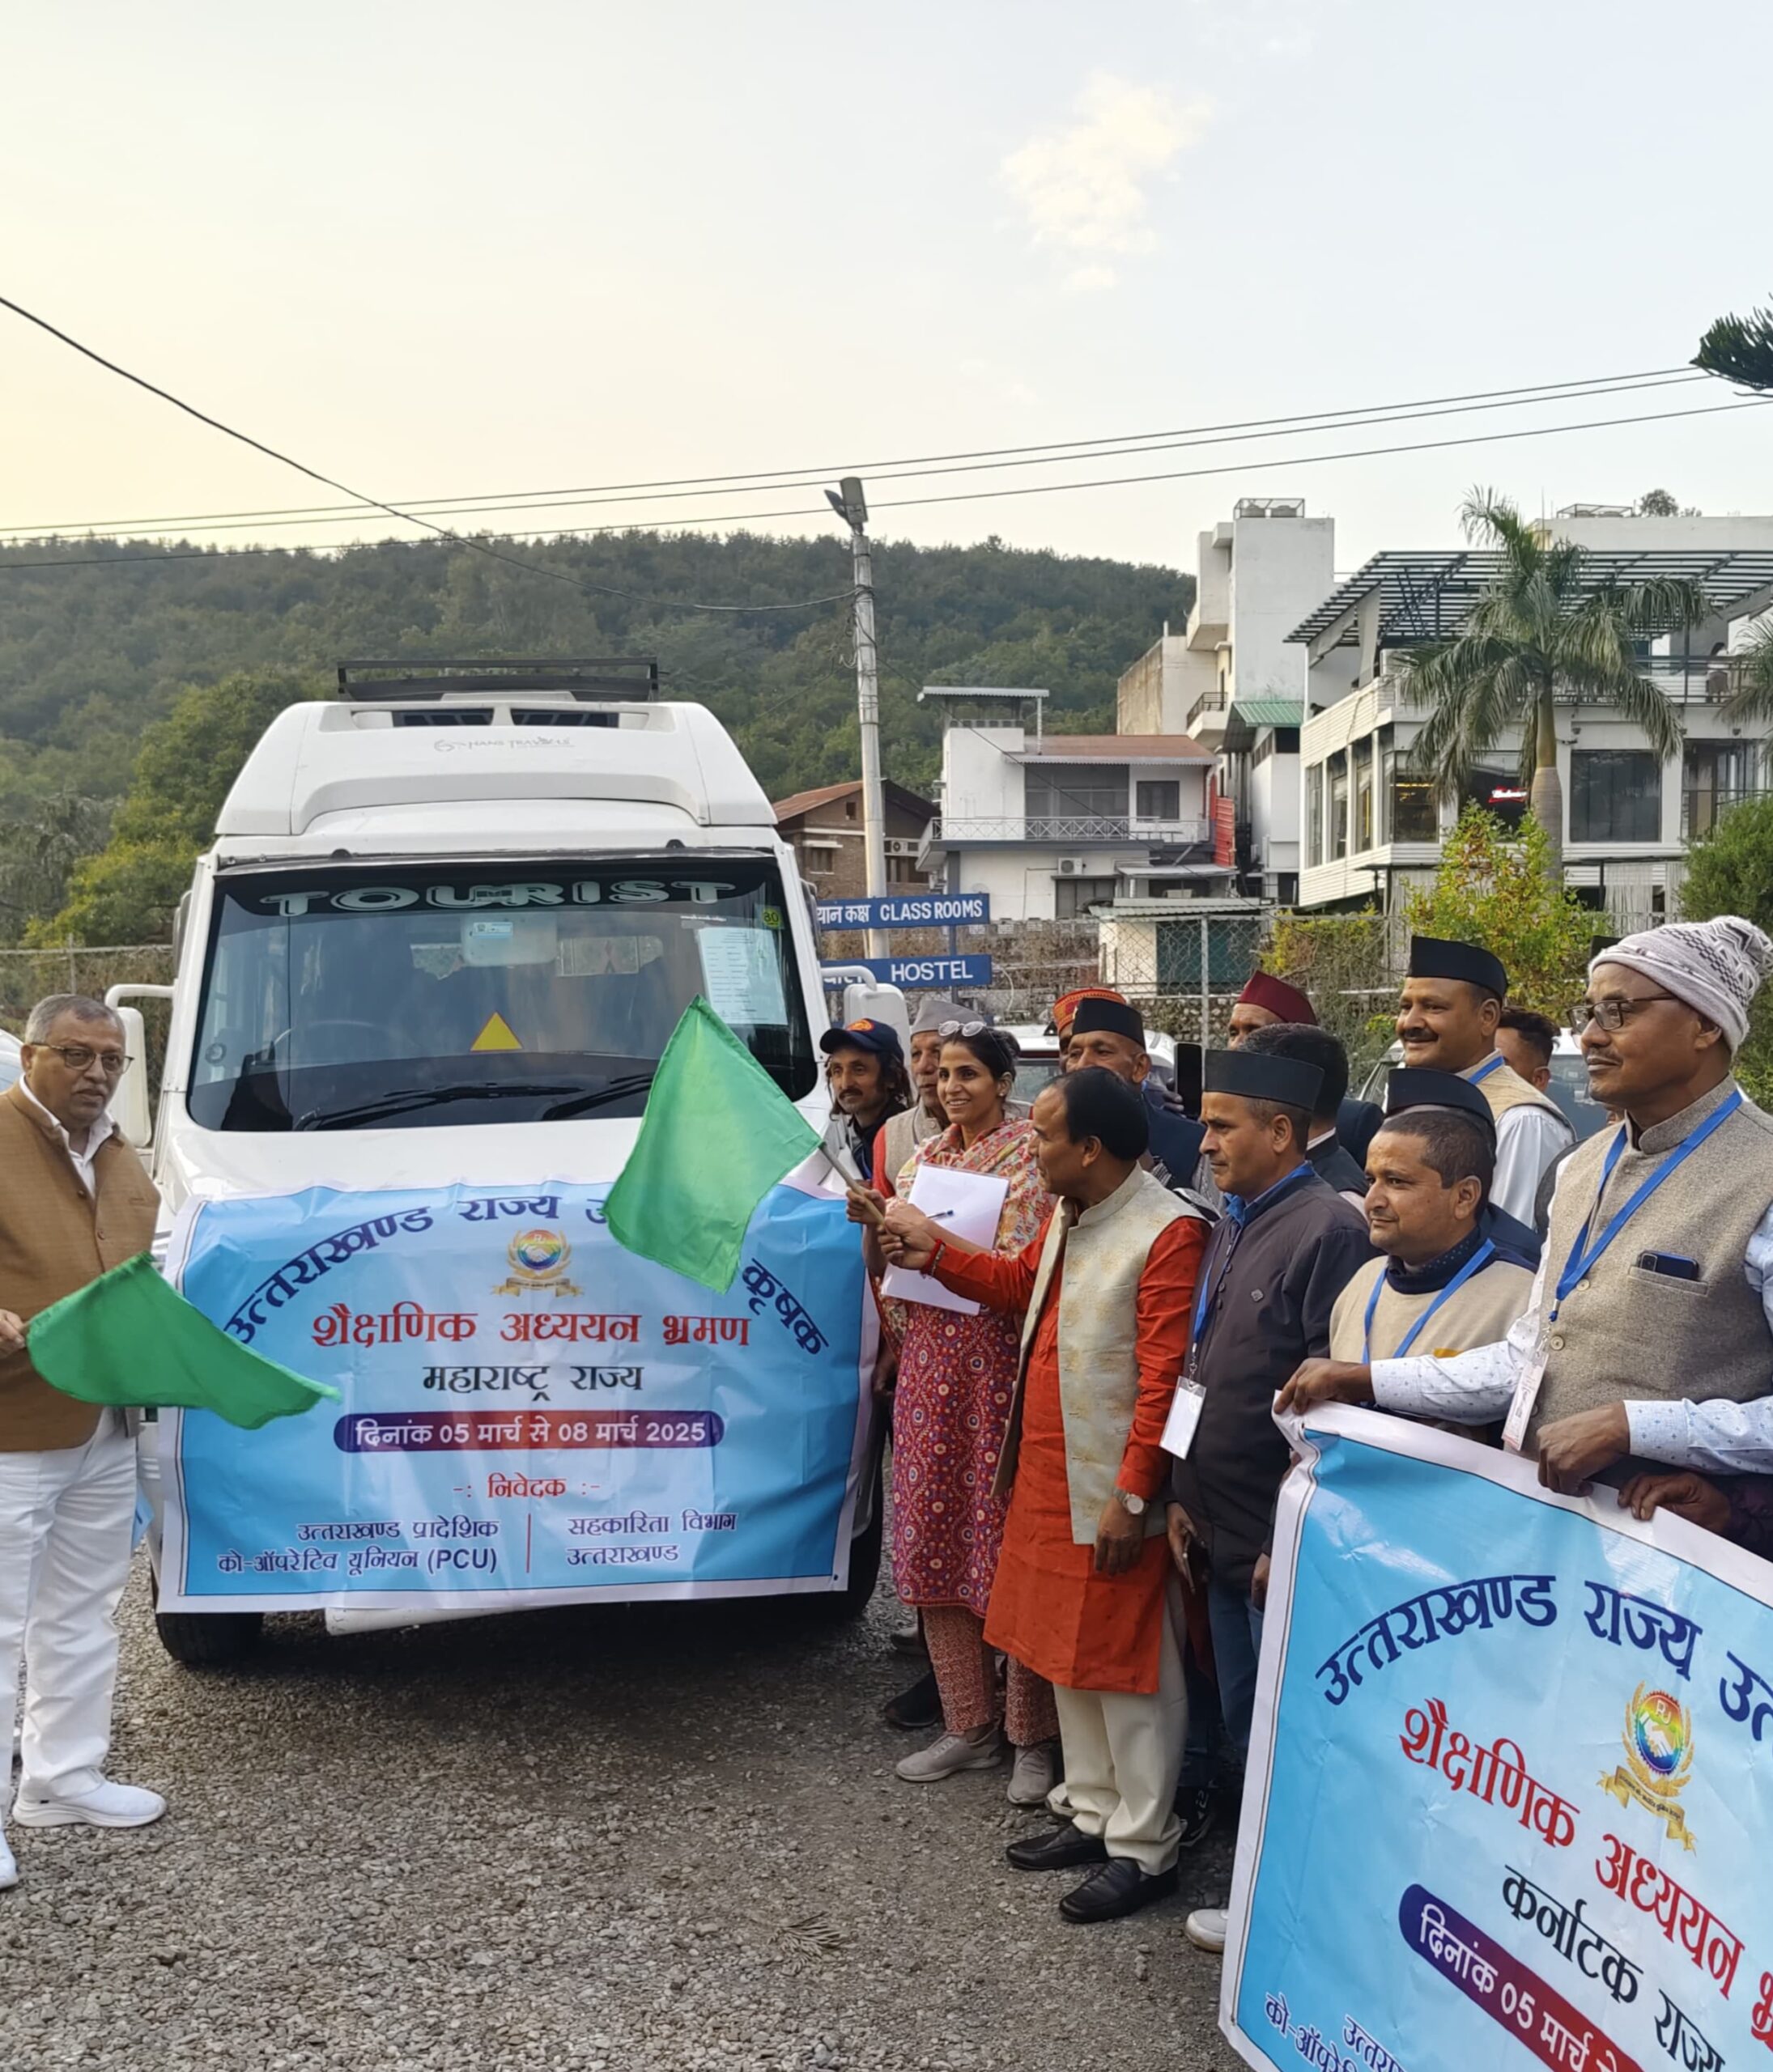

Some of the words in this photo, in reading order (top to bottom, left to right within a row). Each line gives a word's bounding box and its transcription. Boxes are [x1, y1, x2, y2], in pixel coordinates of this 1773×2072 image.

[259, 880, 736, 917] TOURIST
[880, 902, 932, 922] CLASS
[934, 900, 983, 919] ROOMS
[891, 961, 973, 982] HOSTEL
[457, 1195, 562, 1221] राज्य
[742, 1258, 829, 1355] कृषक
[500, 1313, 642, 1342] अध्ययन
[662, 1314, 752, 1346] भ्रमण
[422, 1365, 551, 1401] महाराष्ट्र
[570, 1365, 644, 1391] राज्य
[355, 1418, 433, 1446] दिनांक
[440, 1423, 470, 1443] 05
[478, 1416, 523, 1443] मार्च
[529, 1415, 551, 1442] से
[558, 1422, 588, 1441] 08
[596, 1415, 640, 1442] मार्च
[646, 1422, 706, 1441] 2025
[487, 1471, 567, 1499] निवेदक
[297, 1521, 401, 1540] उत्तराखण्ड
[413, 1514, 500, 1539] प्रादेशिक
[568, 1509, 670, 1535] सहकारिता
[682, 1509, 738, 1531] विभाग
[348, 1545, 420, 1576] यूनियन
[427, 1548, 497, 1574] (PCU)
[567, 1545, 679, 1565] उत्तराखण्ड
[1315, 1574, 1557, 1706] उत्तराखण्ड
[1584, 1581, 1703, 1681] राज्य
[1596, 1833, 1745, 2000] अध्ययन
[1502, 1864, 1644, 2004] कर्नाटक
[1653, 1988, 1726, 2072] राज्य
[1420, 1904, 1499, 1994] दिनांक
[1500, 1981, 1536, 2029] 05
[1540, 2011, 1594, 2072] मार्च
